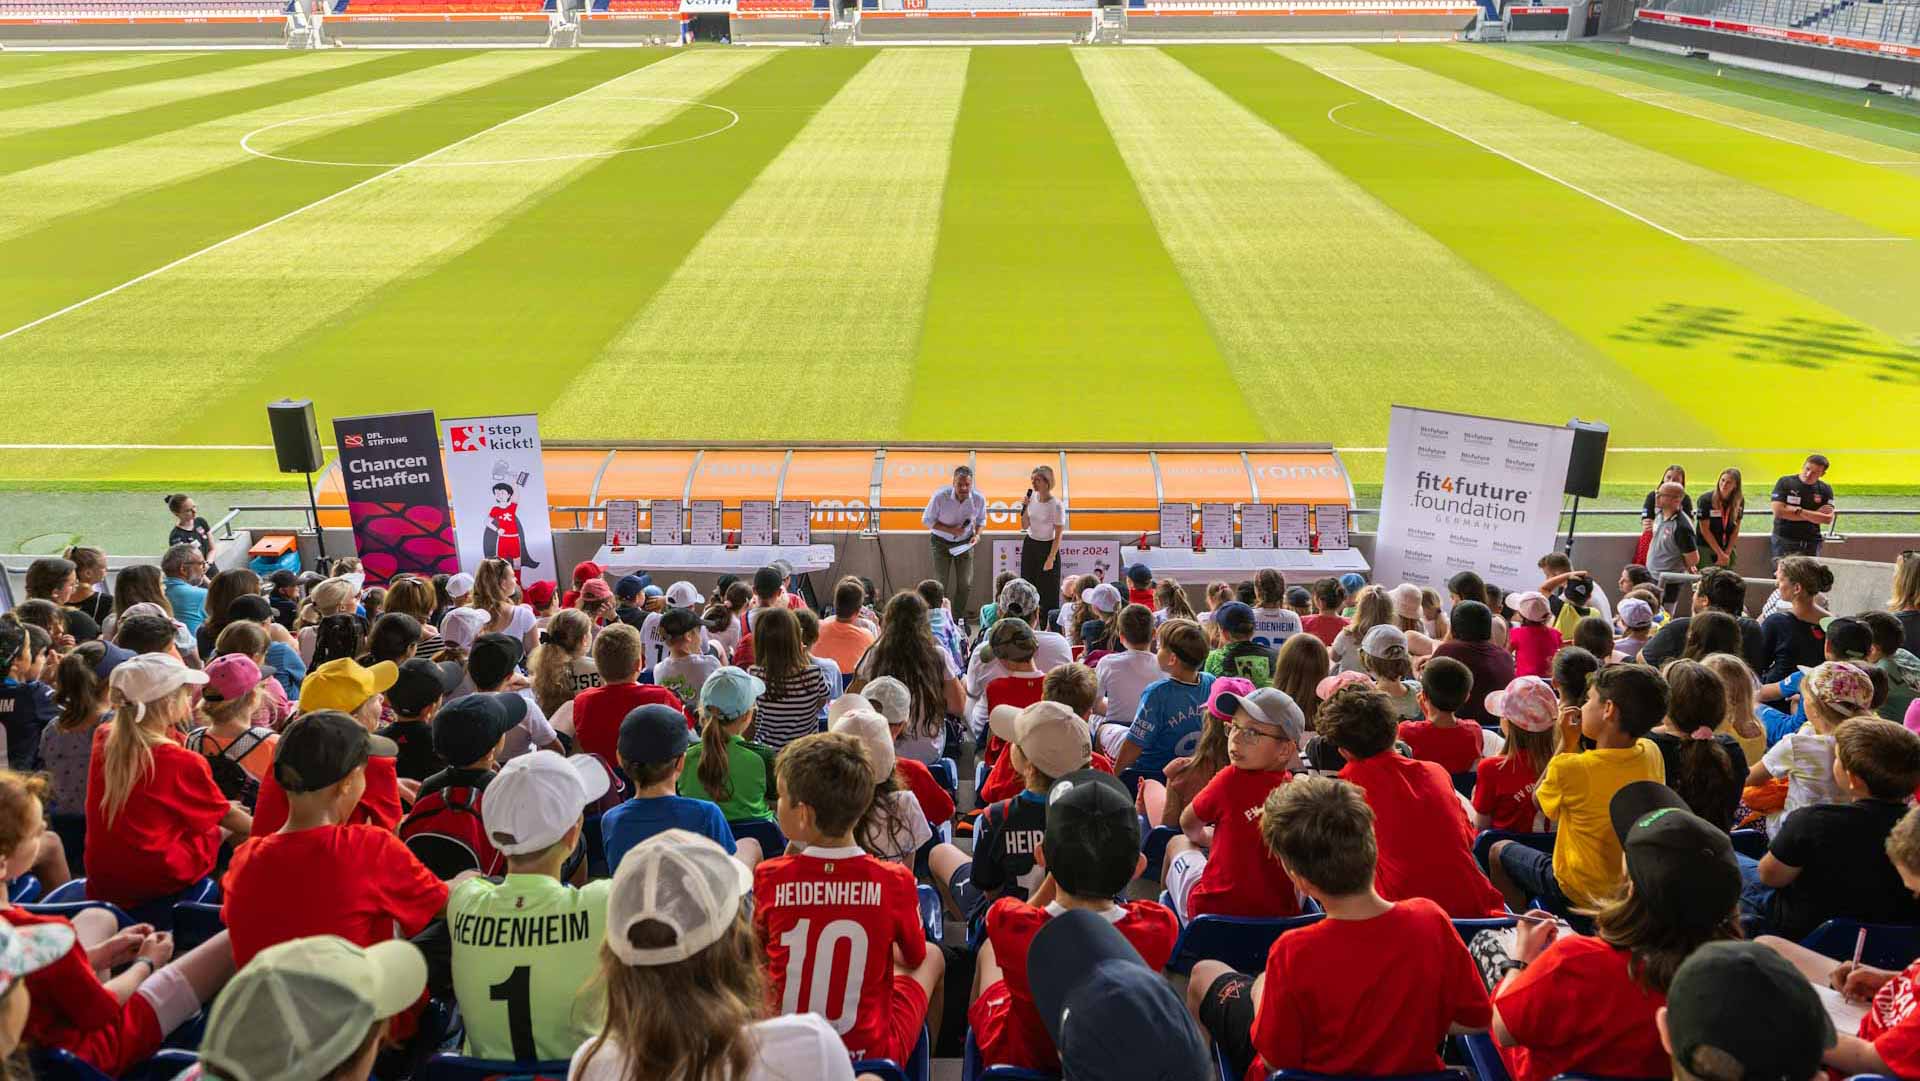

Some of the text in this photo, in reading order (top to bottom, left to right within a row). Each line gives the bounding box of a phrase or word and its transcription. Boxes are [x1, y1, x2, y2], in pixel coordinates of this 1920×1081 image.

[366, 432, 382, 440] DFL
[488, 424, 521, 436] step
[367, 436, 408, 447] STIFTUNG
[490, 437, 534, 450] kickt!
[349, 456, 428, 473] Chancen
[352, 471, 431, 491] schaffen
[1416, 471, 1530, 504] fit4future
[1435, 514, 1499, 530] GERMANY
[1082, 546, 1109, 556] 2024
[1255, 621, 1294, 632] EIDENHEIM
[775, 881, 882, 908] HEIDENHEIM
[454, 910, 590, 948] HEIDENHEIM
[780, 918, 869, 1036] 10
[489, 965, 539, 1062] 1
